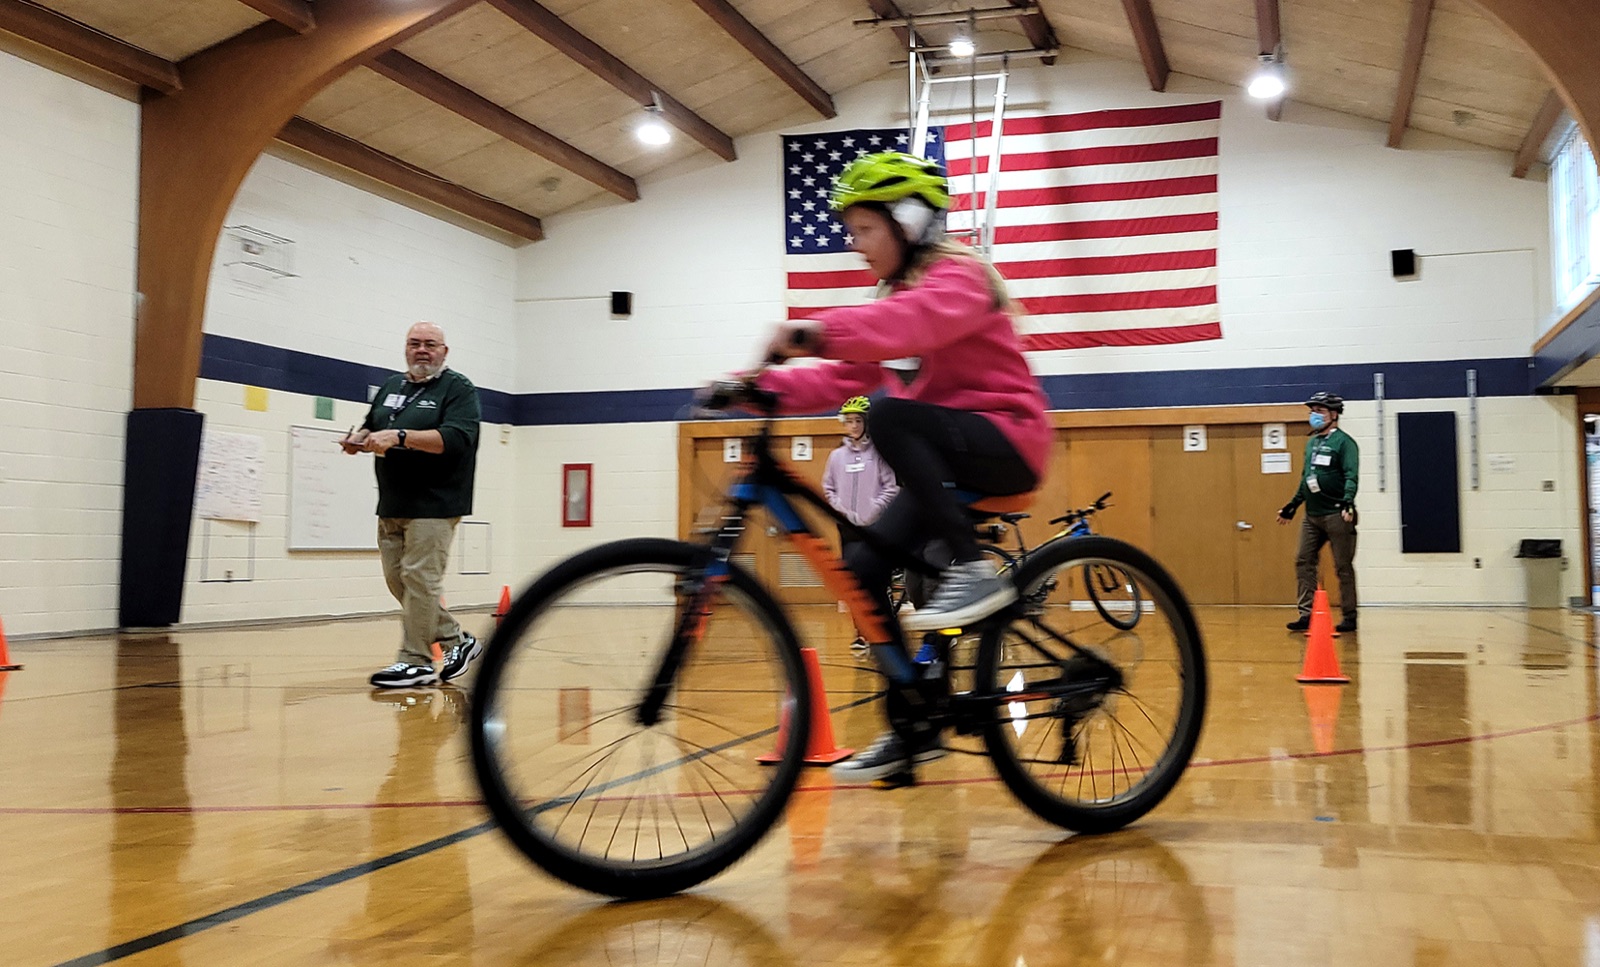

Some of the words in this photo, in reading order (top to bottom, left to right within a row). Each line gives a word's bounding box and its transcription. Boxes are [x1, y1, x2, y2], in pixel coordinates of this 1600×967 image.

[1189, 431, 1201, 447] 5
[1268, 429, 1281, 445] 6
[796, 442, 807, 457] 2
